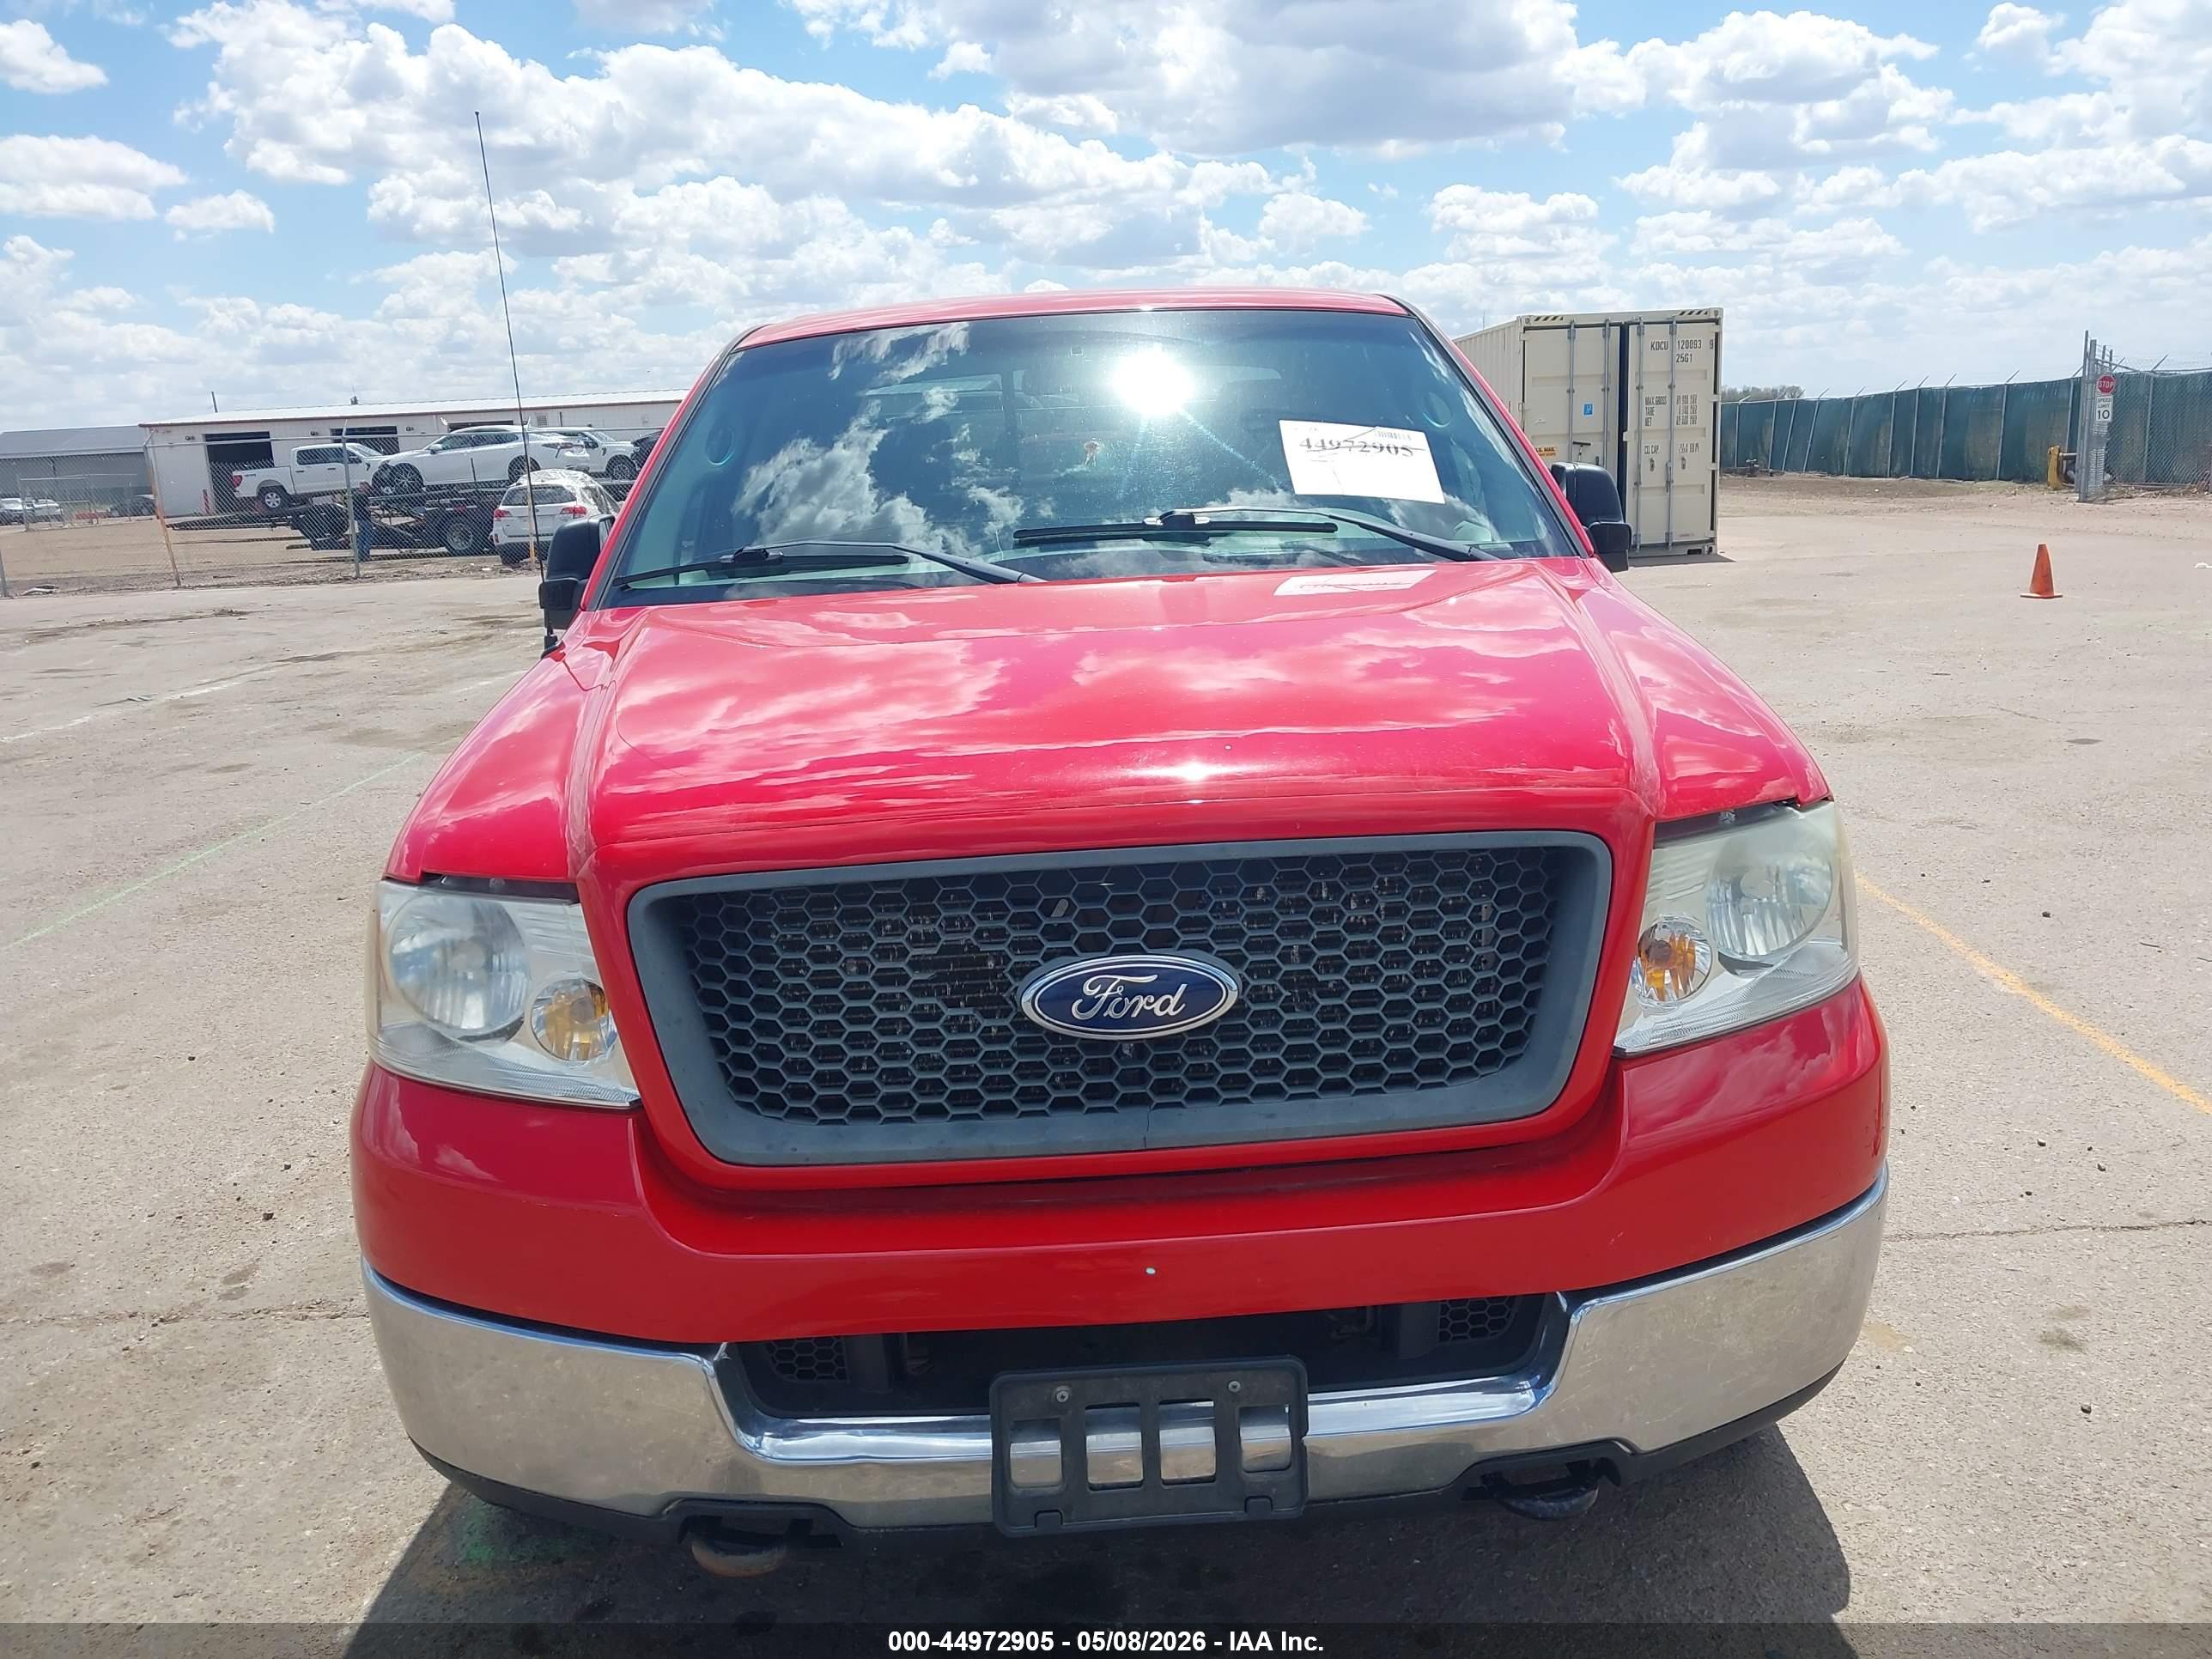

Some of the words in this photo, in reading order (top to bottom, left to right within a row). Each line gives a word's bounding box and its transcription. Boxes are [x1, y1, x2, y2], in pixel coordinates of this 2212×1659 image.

[1677, 340, 1702, 349] 120093
[1710, 339, 1714, 349] 9
[2098, 380, 2114, 389] STOP
[2098, 410, 2110, 420] 10
[1299, 437, 1413, 458] 44972905
[1072, 974, 1188, 1020] Ford
